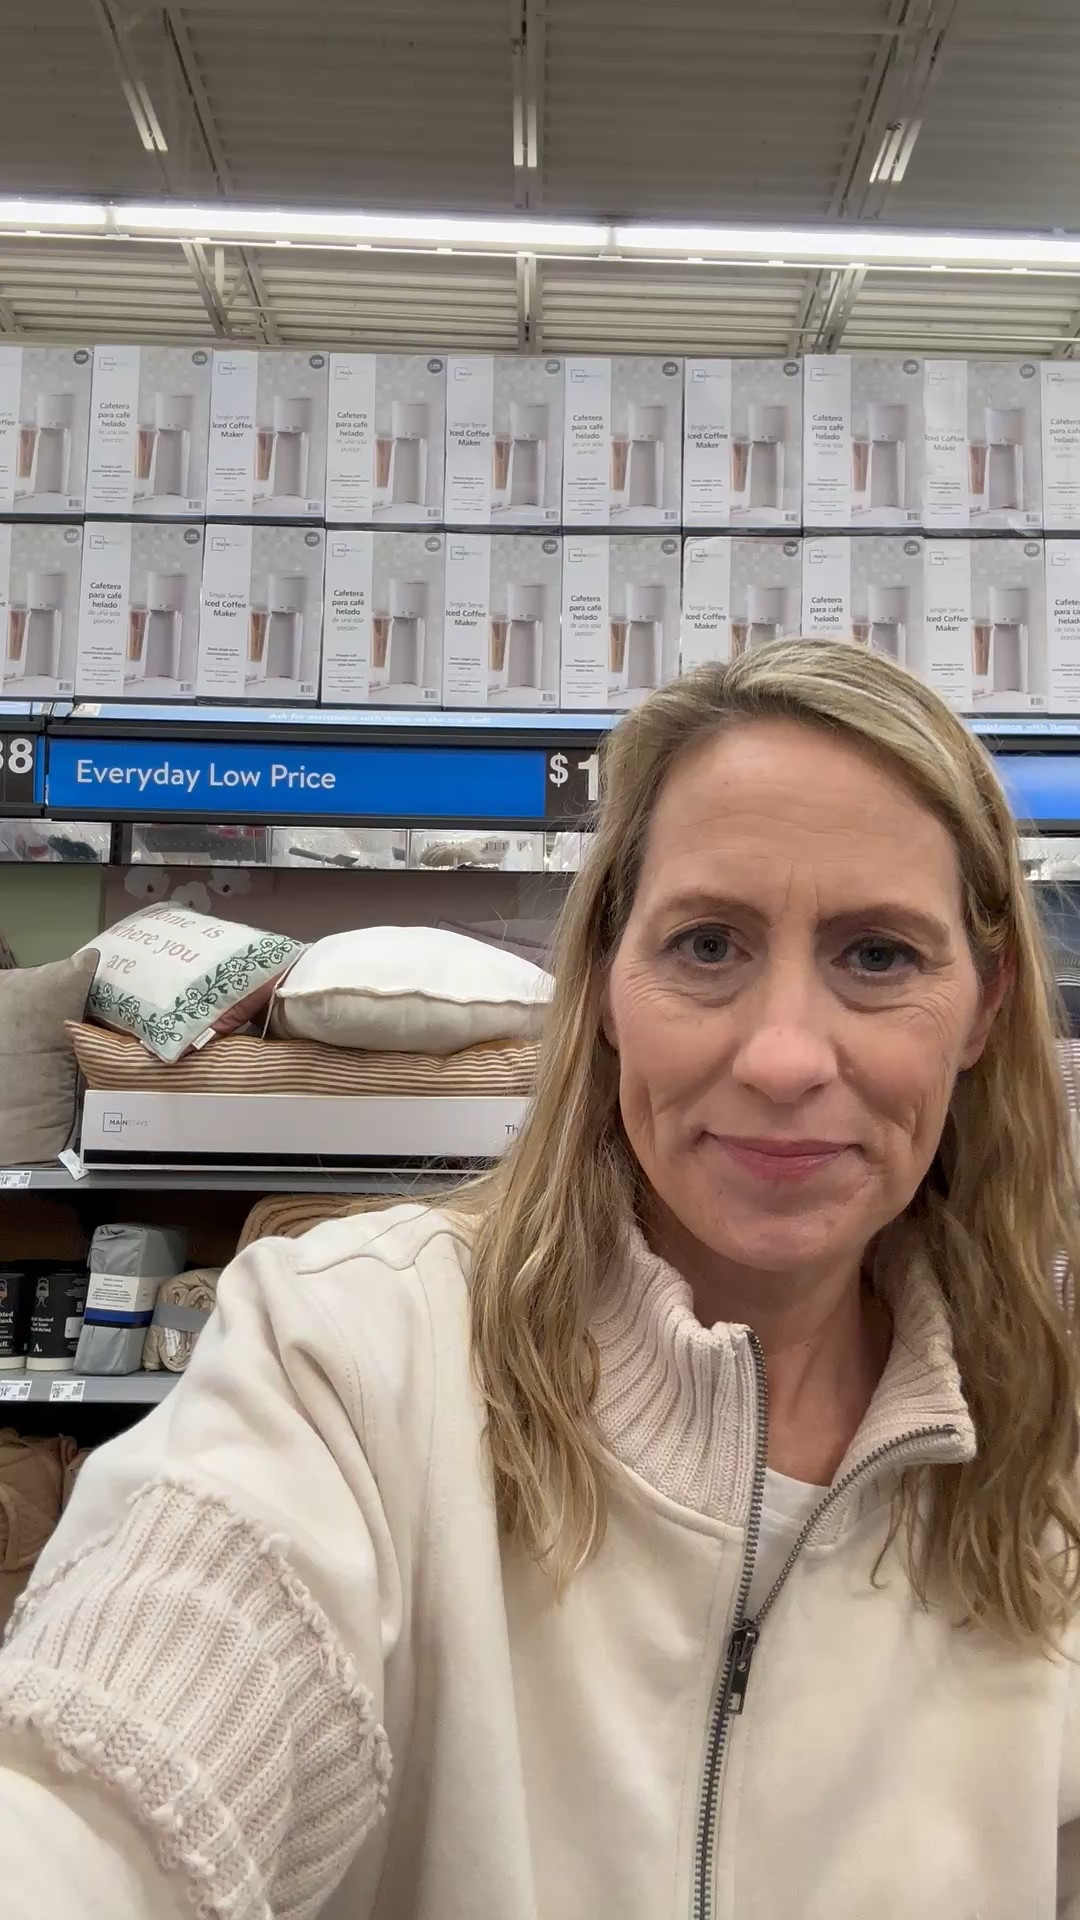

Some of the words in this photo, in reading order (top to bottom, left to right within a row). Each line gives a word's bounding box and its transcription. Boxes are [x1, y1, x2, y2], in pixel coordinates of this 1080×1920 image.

[100, 402, 130, 410] Cafetera
[98, 412, 114, 420] para
[90, 582, 121, 590] Cafetera
[222, 600, 246, 608] Coffee
[463, 610, 486, 618] Coffee
[269, 712, 288, 720] Ask
[0, 738, 33, 774] 8
[77, 760, 200, 792] Everyday
[210, 763, 260, 787] Low
[272, 764, 336, 789] Price
[142, 908, 195, 928] Home
[200, 925, 224, 939] is
[107, 924, 159, 945] where
[152, 939, 200, 964] you
[107, 955, 136, 974] are
[505, 1124, 519, 1134] Th
